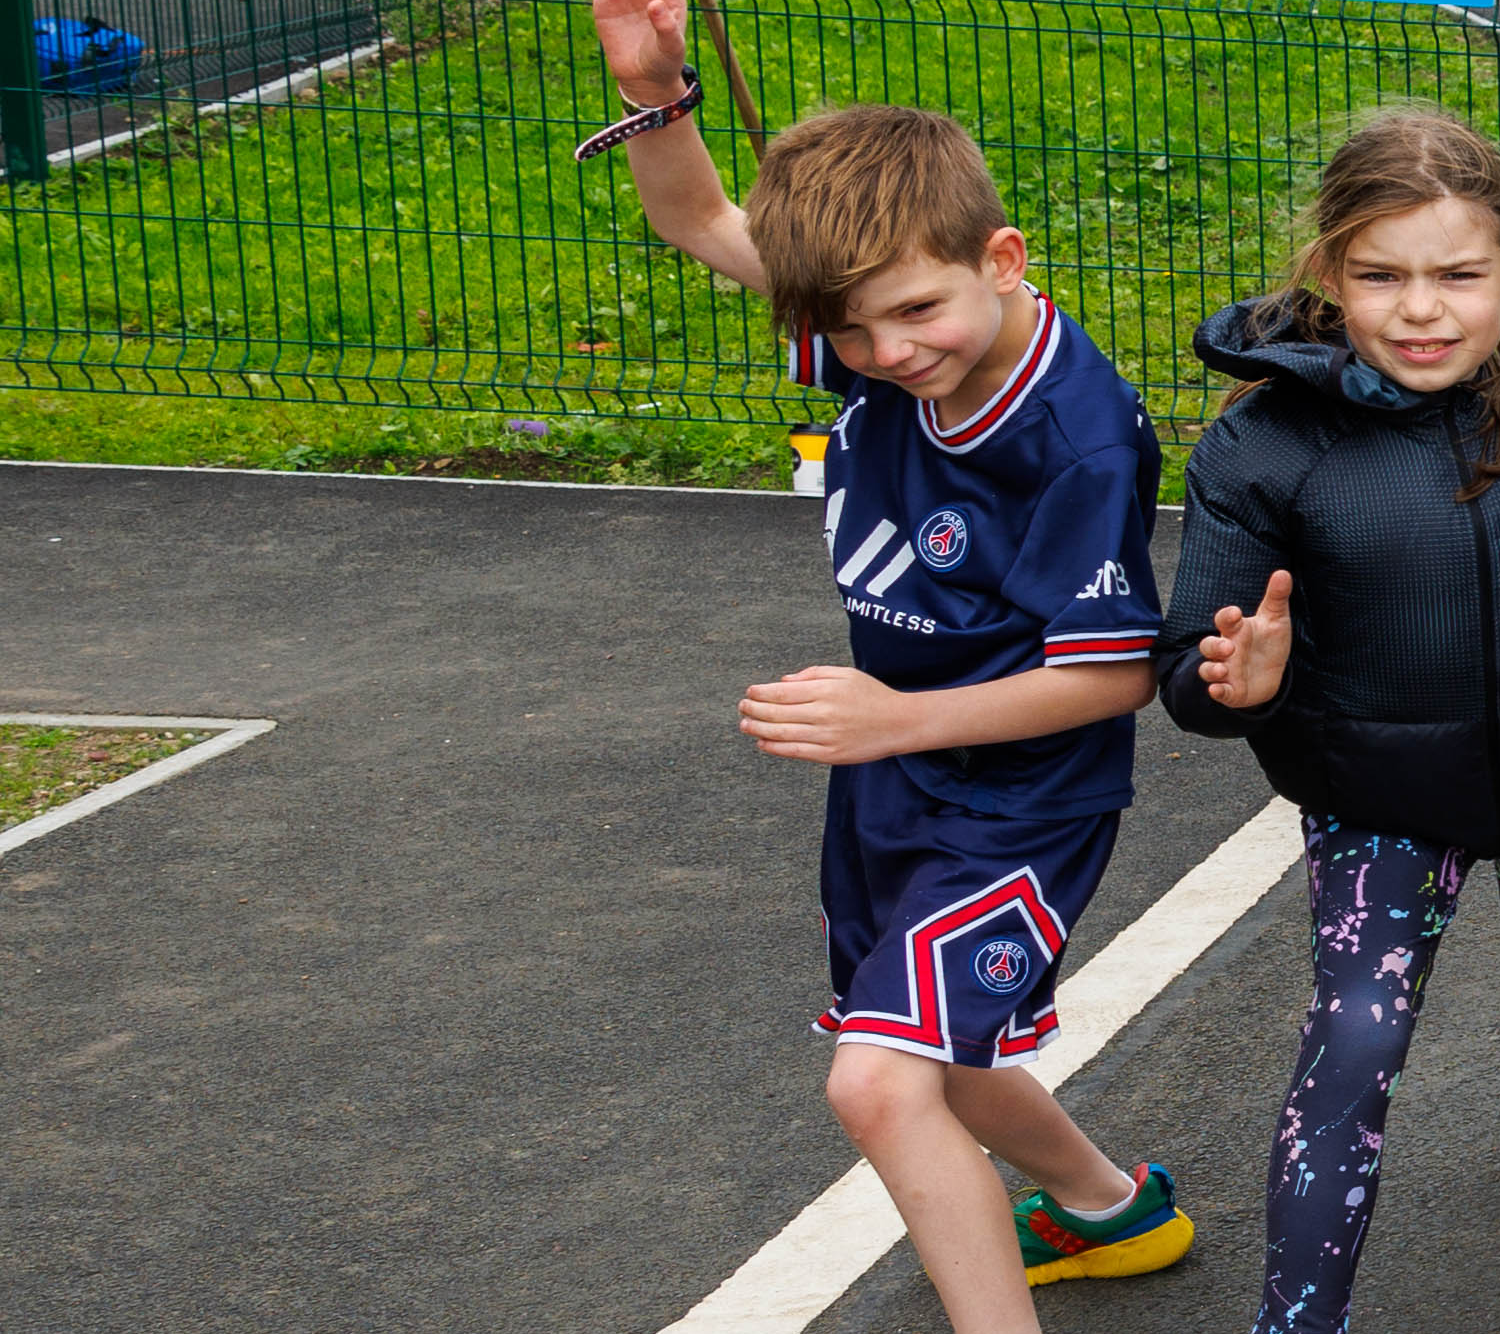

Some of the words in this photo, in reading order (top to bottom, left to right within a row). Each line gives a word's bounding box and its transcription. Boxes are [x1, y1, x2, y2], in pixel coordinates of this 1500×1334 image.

[942, 513, 968, 540] PARIS
[842, 596, 937, 634] IMITLESS
[988, 943, 1025, 959] PARIS
